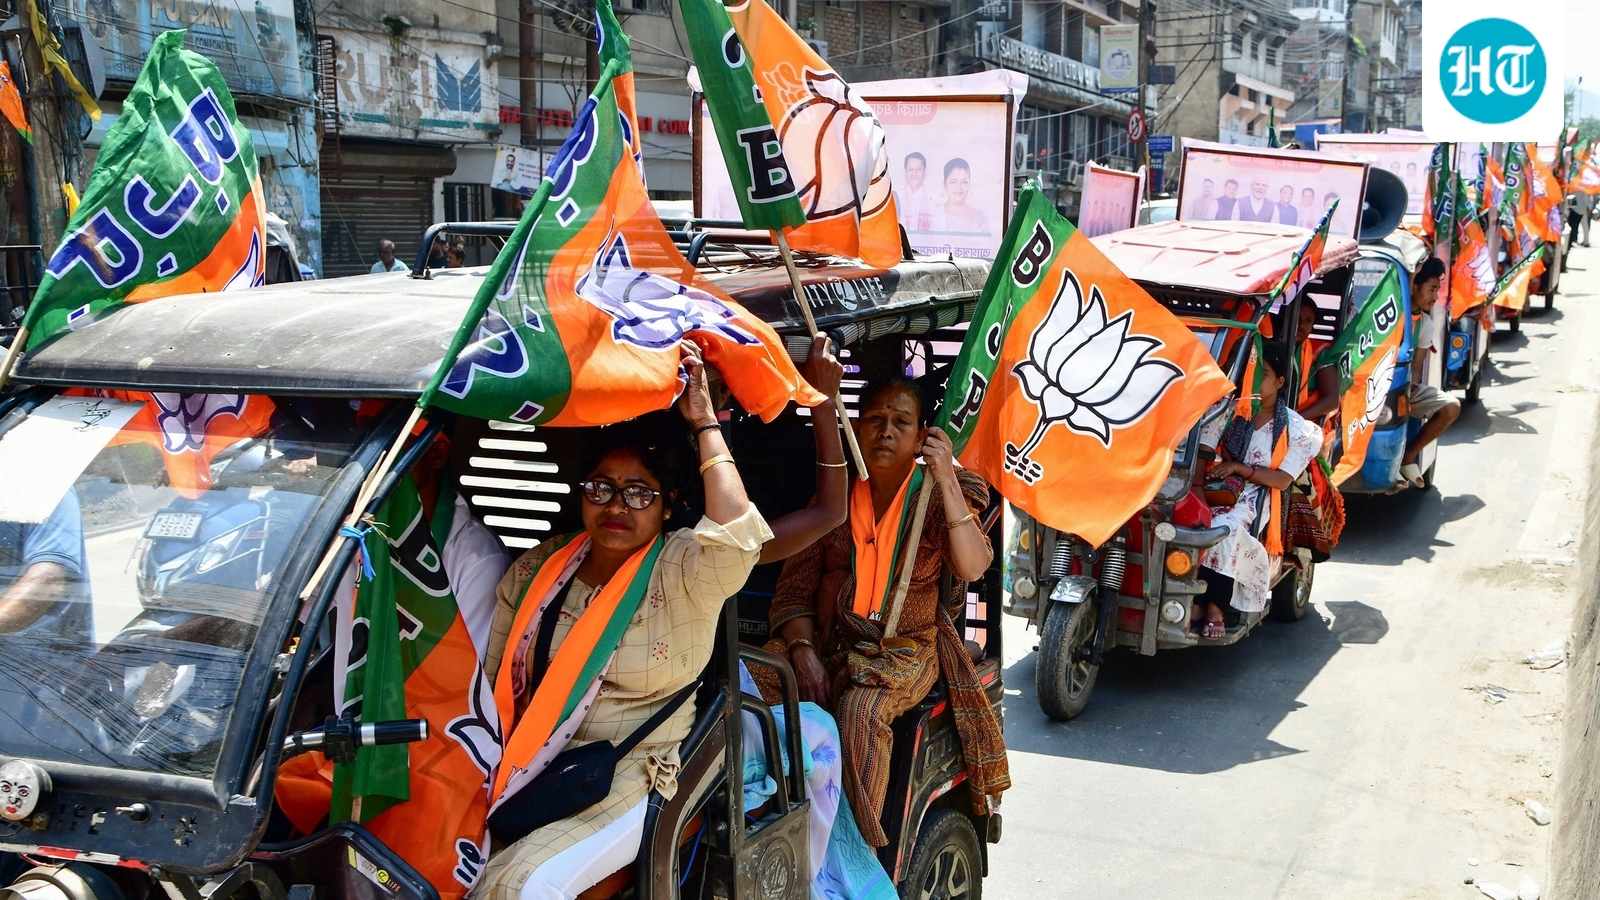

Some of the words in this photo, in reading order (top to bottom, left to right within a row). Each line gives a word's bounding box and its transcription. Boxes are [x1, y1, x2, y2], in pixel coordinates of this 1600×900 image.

[499, 106, 572, 127] MAUTI
[738, 621, 768, 632] HUJA
[386, 879, 401, 892] LIFE
